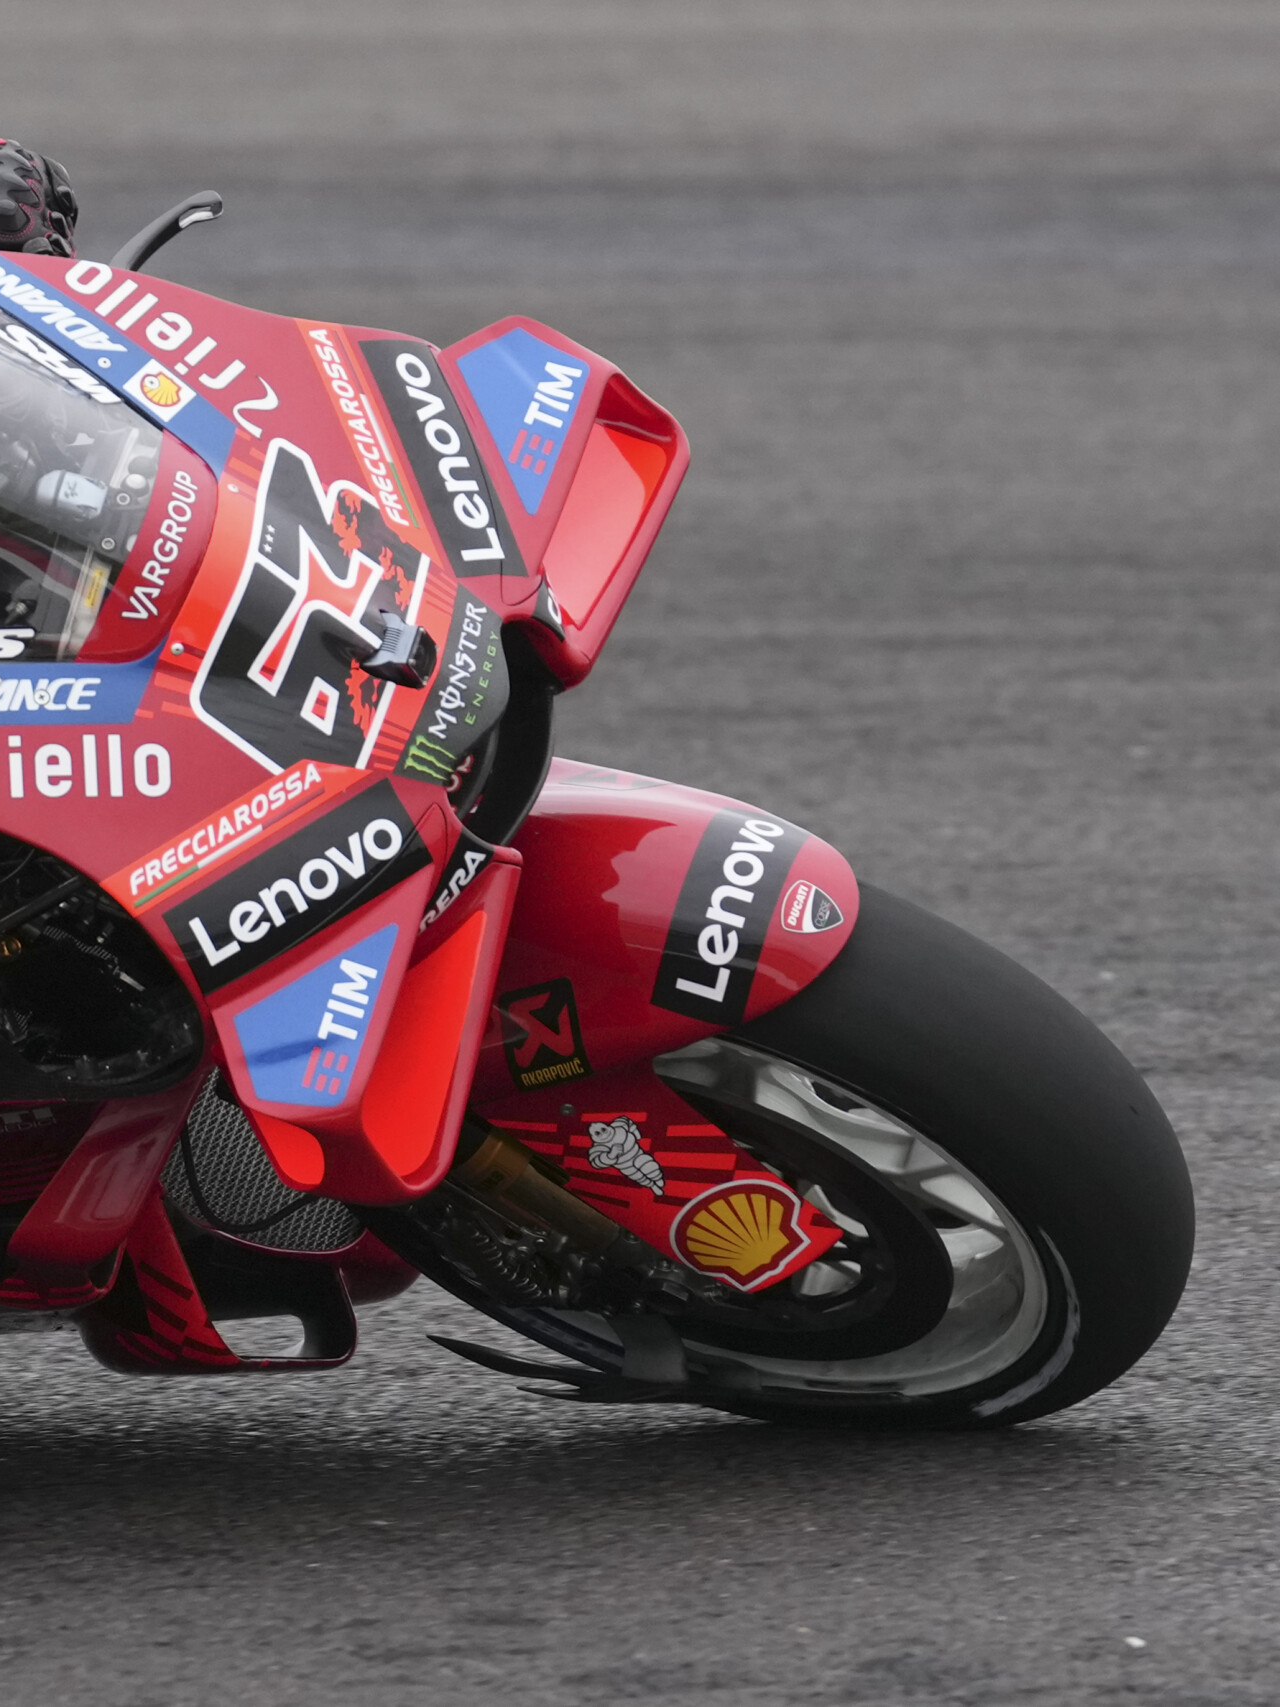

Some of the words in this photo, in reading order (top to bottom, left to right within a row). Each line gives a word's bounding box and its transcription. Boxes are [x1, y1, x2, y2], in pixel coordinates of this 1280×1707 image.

[65, 260, 247, 391] riello
[308, 328, 410, 527] FRECCIAROSSA
[395, 352, 506, 562] Lenovo
[523, 361, 583, 428] TIM
[122, 470, 198, 620] VARGROUP
[428, 601, 488, 740] MONSTER
[465, 631, 499, 725] ENERGY
[129, 765, 323, 896] FRECCIAROSSA
[189, 818, 403, 967] Lenovo
[419, 851, 487, 935] RERA
[675, 818, 784, 1002] Lenovo
[787, 885, 809, 927] DUCATI
[318, 959, 378, 1041] TIM
[521, 1058, 585, 1087] AKRAPOVIČ
